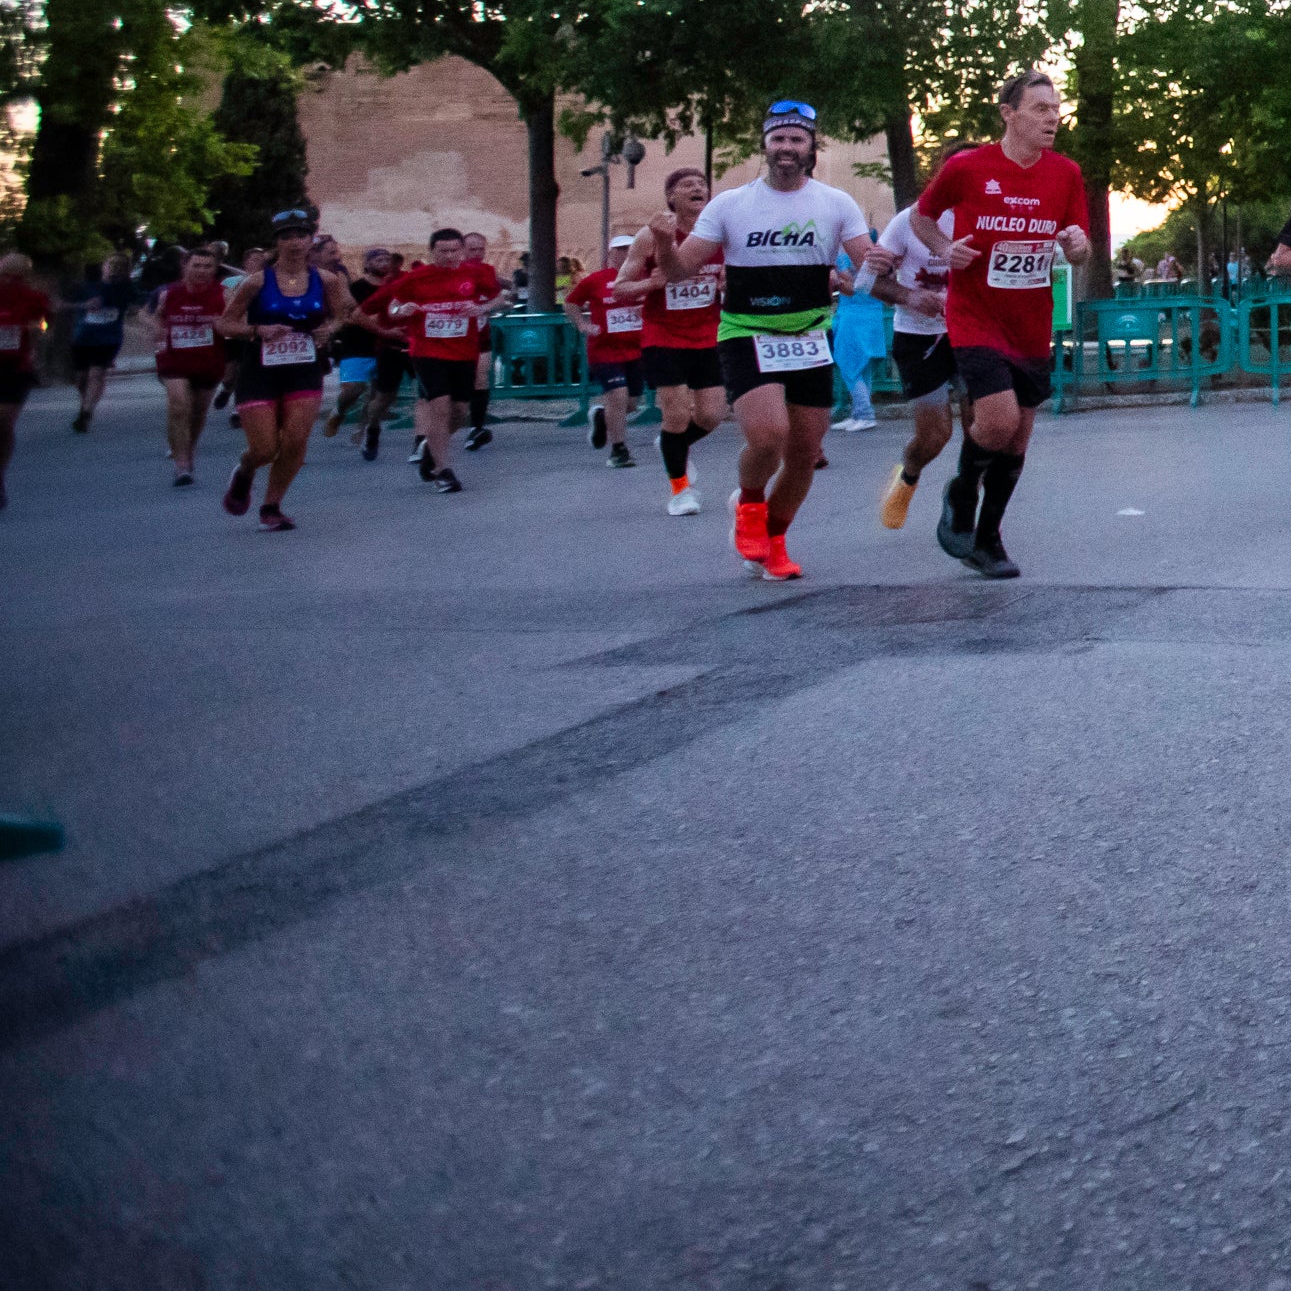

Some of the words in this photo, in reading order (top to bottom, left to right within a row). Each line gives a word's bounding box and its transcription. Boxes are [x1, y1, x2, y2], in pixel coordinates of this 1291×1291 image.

[976, 216, 1025, 232] NUCLEO
[1028, 218, 1057, 235] DURO
[993, 254, 1046, 273] 2281
[669, 284, 711, 300] 1404
[427, 318, 462, 329] 4079
[266, 340, 308, 356] 2092
[761, 341, 819, 359] 3883
